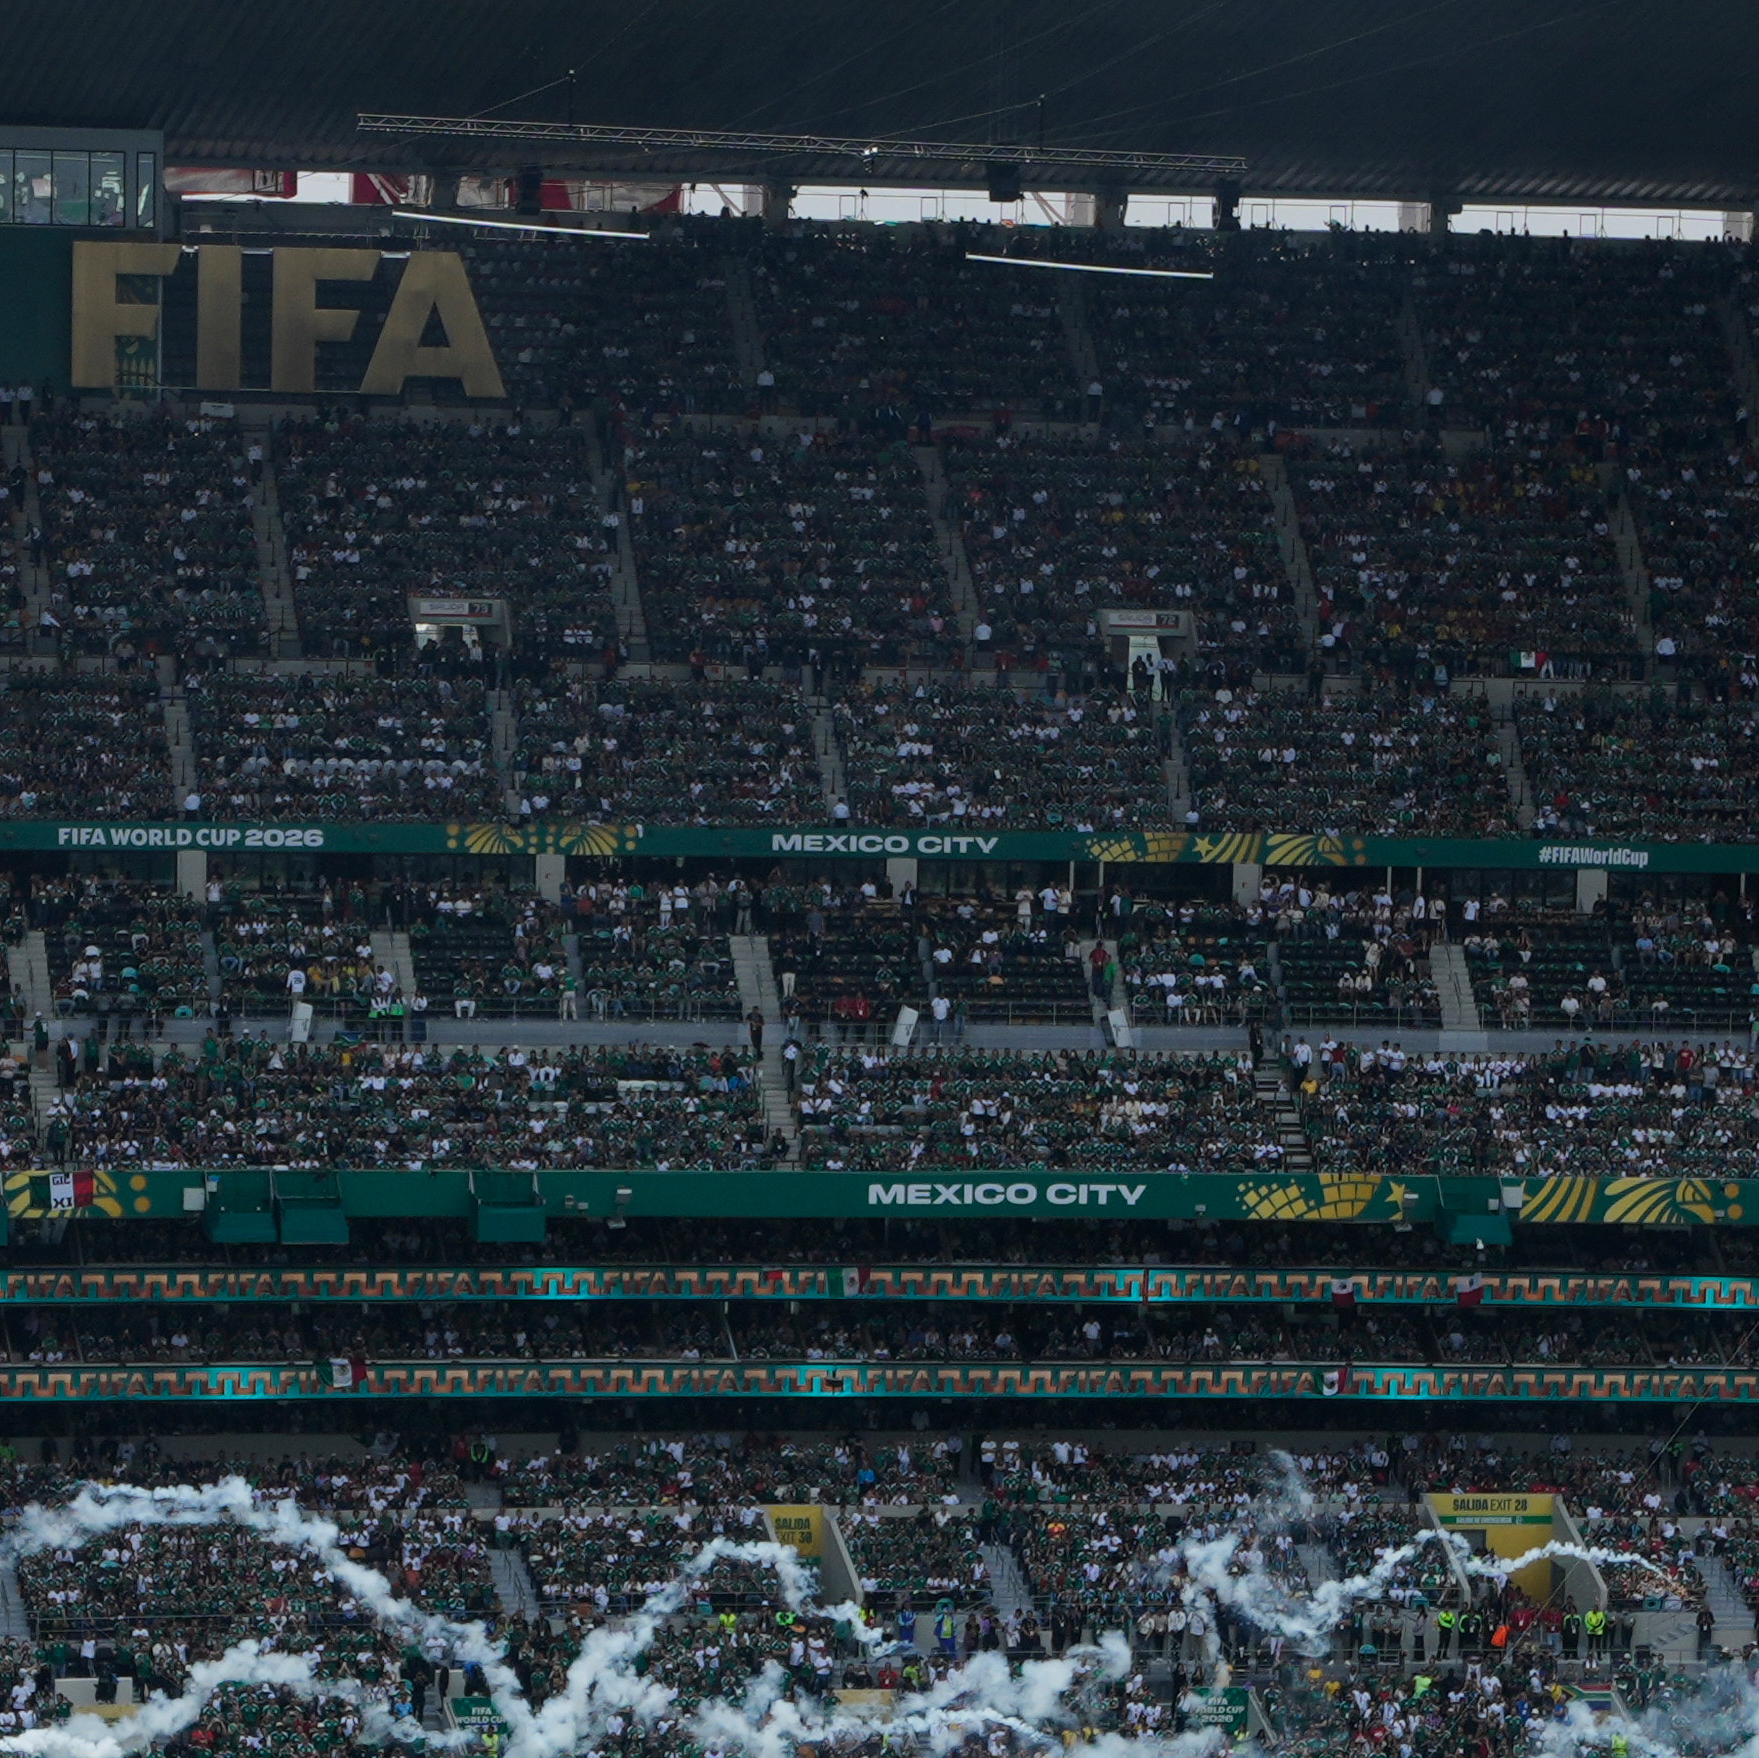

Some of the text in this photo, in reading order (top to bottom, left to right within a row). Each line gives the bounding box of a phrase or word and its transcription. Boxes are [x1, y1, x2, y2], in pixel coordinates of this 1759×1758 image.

[72, 241, 506, 398] FIFA
[58, 827, 324, 848] FIFA WORLD CUP 2026
[772, 833, 998, 855] MEXICO CITY
[1539, 845, 1648, 869] #FIFAWorldCup
[868, 1183, 1147, 1206] MEXICO CITY
[8, 1274, 78, 1299] FIFA
[208, 1273, 277, 1297] FIFA
[408, 1272, 477, 1296] FIFA
[603, 1272, 670, 1296] FIFA
[993, 1273, 1056, 1297] FIFA
[1185, 1274, 1248, 1299] FIFA
[1380, 1276, 1444, 1300] FIFA
[1568, 1279, 1632, 1304] FIFA
[82, 1373, 148, 1398] FIFA
[477, 1370, 541, 1394] FIFA
[672, 1369, 740, 1394] FIFA
[868, 1369, 933, 1394] FIFA
[1059, 1370, 1127, 1395] FIFA
[1252, 1371, 1317, 1396] FIFA
[1446, 1373, 1511, 1398] FIFA
[1633, 1376, 1698, 1399] FIFA
[1453, 1499, 1528, 1511] SALIDA EXIT 28
[775, 1517, 810, 1530] SALIDA
[471, 1706, 492, 1716] FIFA
[1208, 1697, 1229, 1706] FIFA
[1226, 1705, 1245, 1714] CUP
